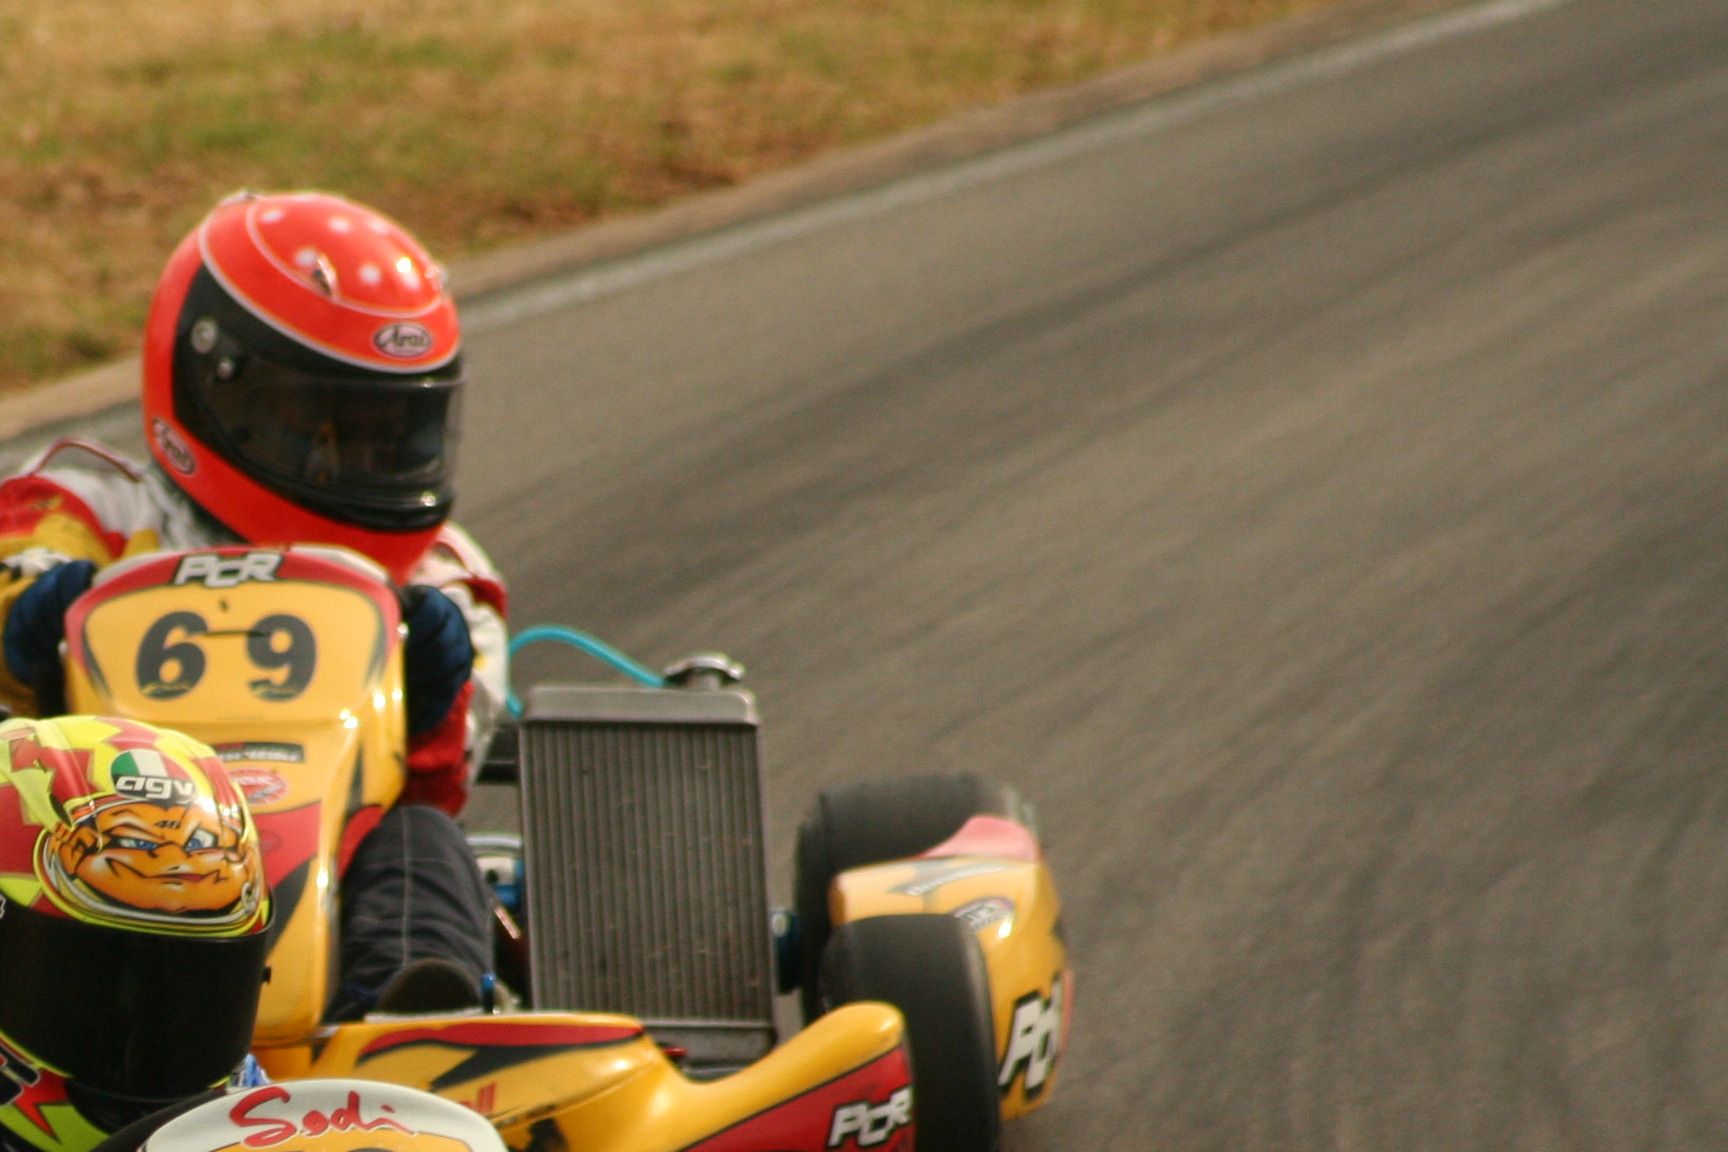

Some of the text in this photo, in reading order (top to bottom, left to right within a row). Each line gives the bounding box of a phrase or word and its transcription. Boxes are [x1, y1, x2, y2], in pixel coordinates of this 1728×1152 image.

[175, 551, 283, 588] PCR
[135, 611, 316, 702] 69
[116, 774, 195, 800] agv
[229, 1086, 417, 1148] Sodi
